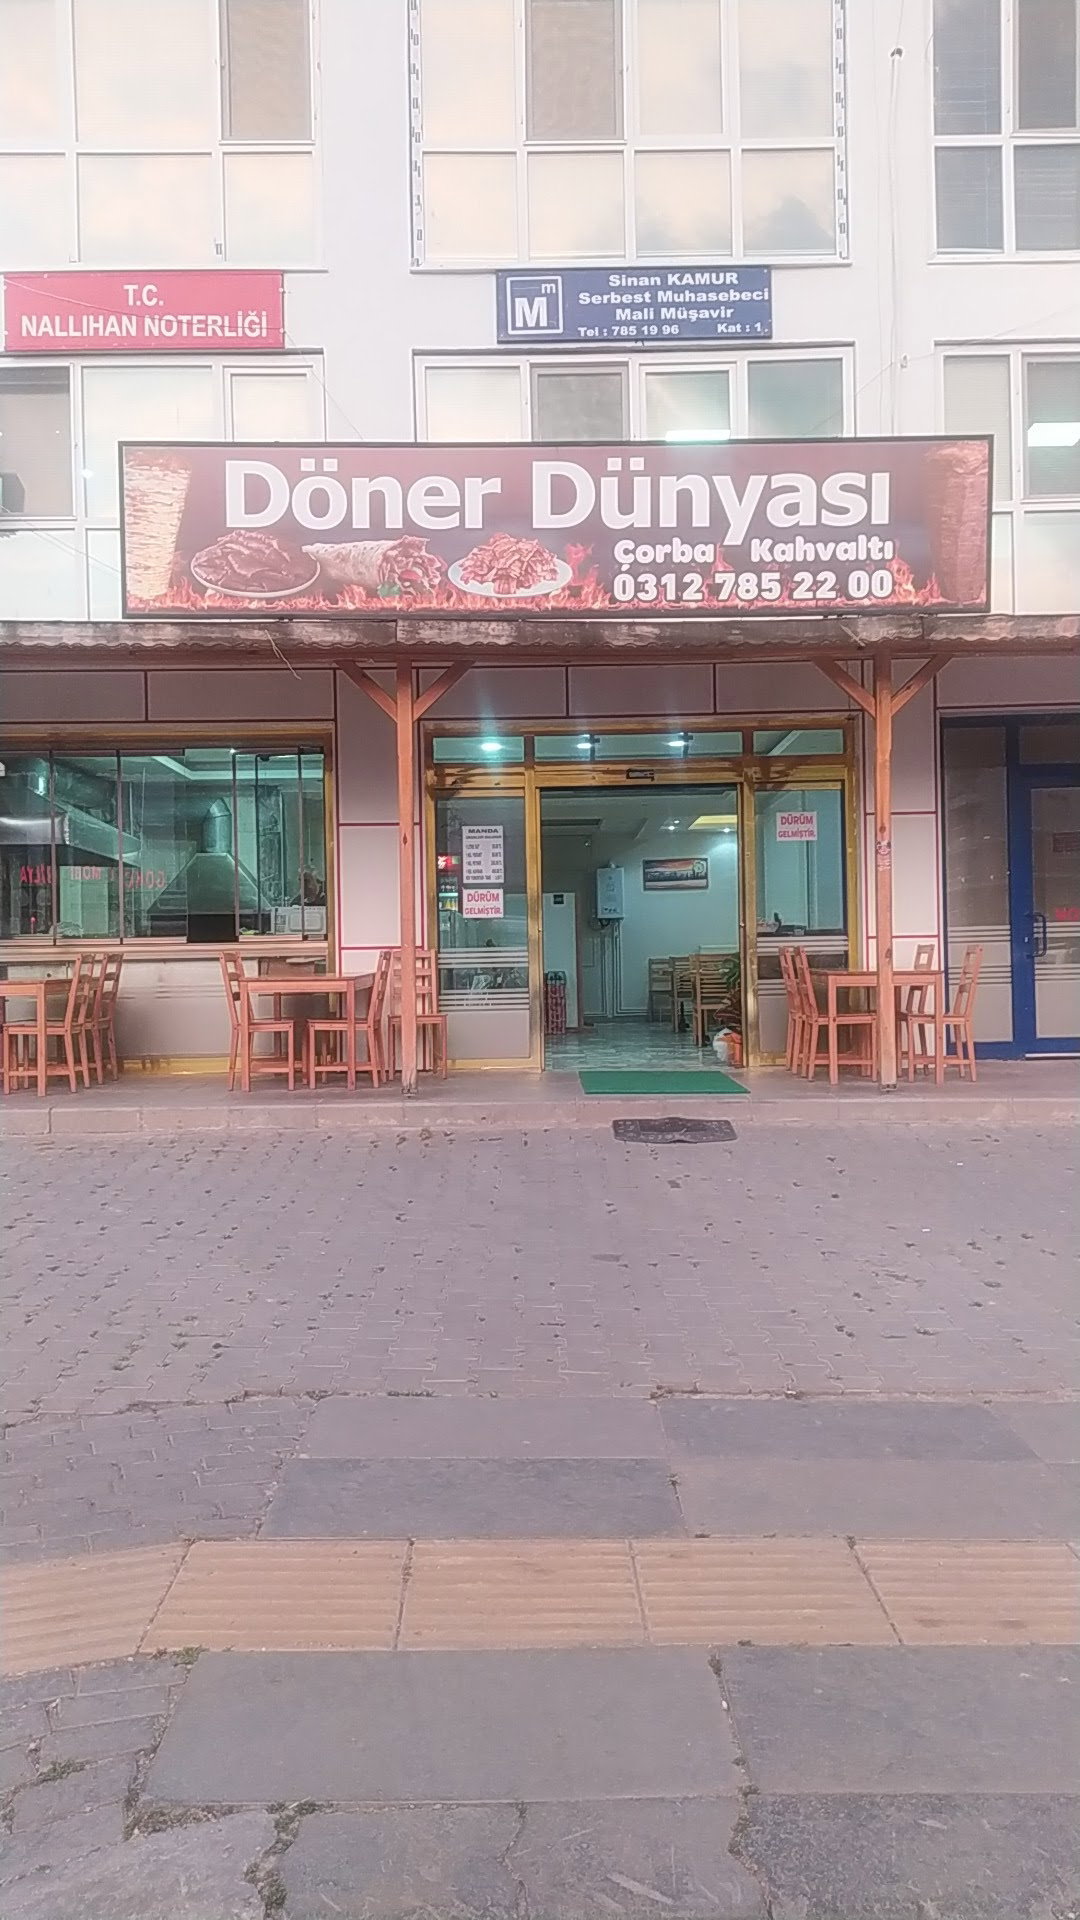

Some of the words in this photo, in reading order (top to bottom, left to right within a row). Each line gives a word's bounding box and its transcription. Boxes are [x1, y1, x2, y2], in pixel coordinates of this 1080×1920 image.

[608, 274, 661, 286] Sinan
[667, 272, 739, 286] KAMUR
[123, 284, 164, 307] T.C.
[578, 291, 652, 305] Serbest
[657, 288, 769, 303] Muhasebeci
[615, 308, 654, 321] Mali
[660, 306, 734, 322] Müşavir
[20, 314, 137, 337] NALLIHAN
[144, 311, 267, 337] NOTERLİĞİ
[578, 327, 599, 338] Tel
[611, 325, 637, 337] 785
[641, 325, 658, 336] 19
[662, 324, 679, 335] 96
[717, 322, 742, 333] Kat
[225, 458, 502, 530] Döner
[532, 457, 891, 546] Dünyası
[613, 537, 715, 571] Çorba
[750, 534, 894, 563] Kahvaltı
[613, 573, 703, 602] 0312
[714, 572, 781, 601] 785
[792, 570, 837, 599] 22
[847, 569, 894, 599] 00
[780, 813, 814, 825] DÜRÜM
[467, 891, 500, 903] DÜRÜM
